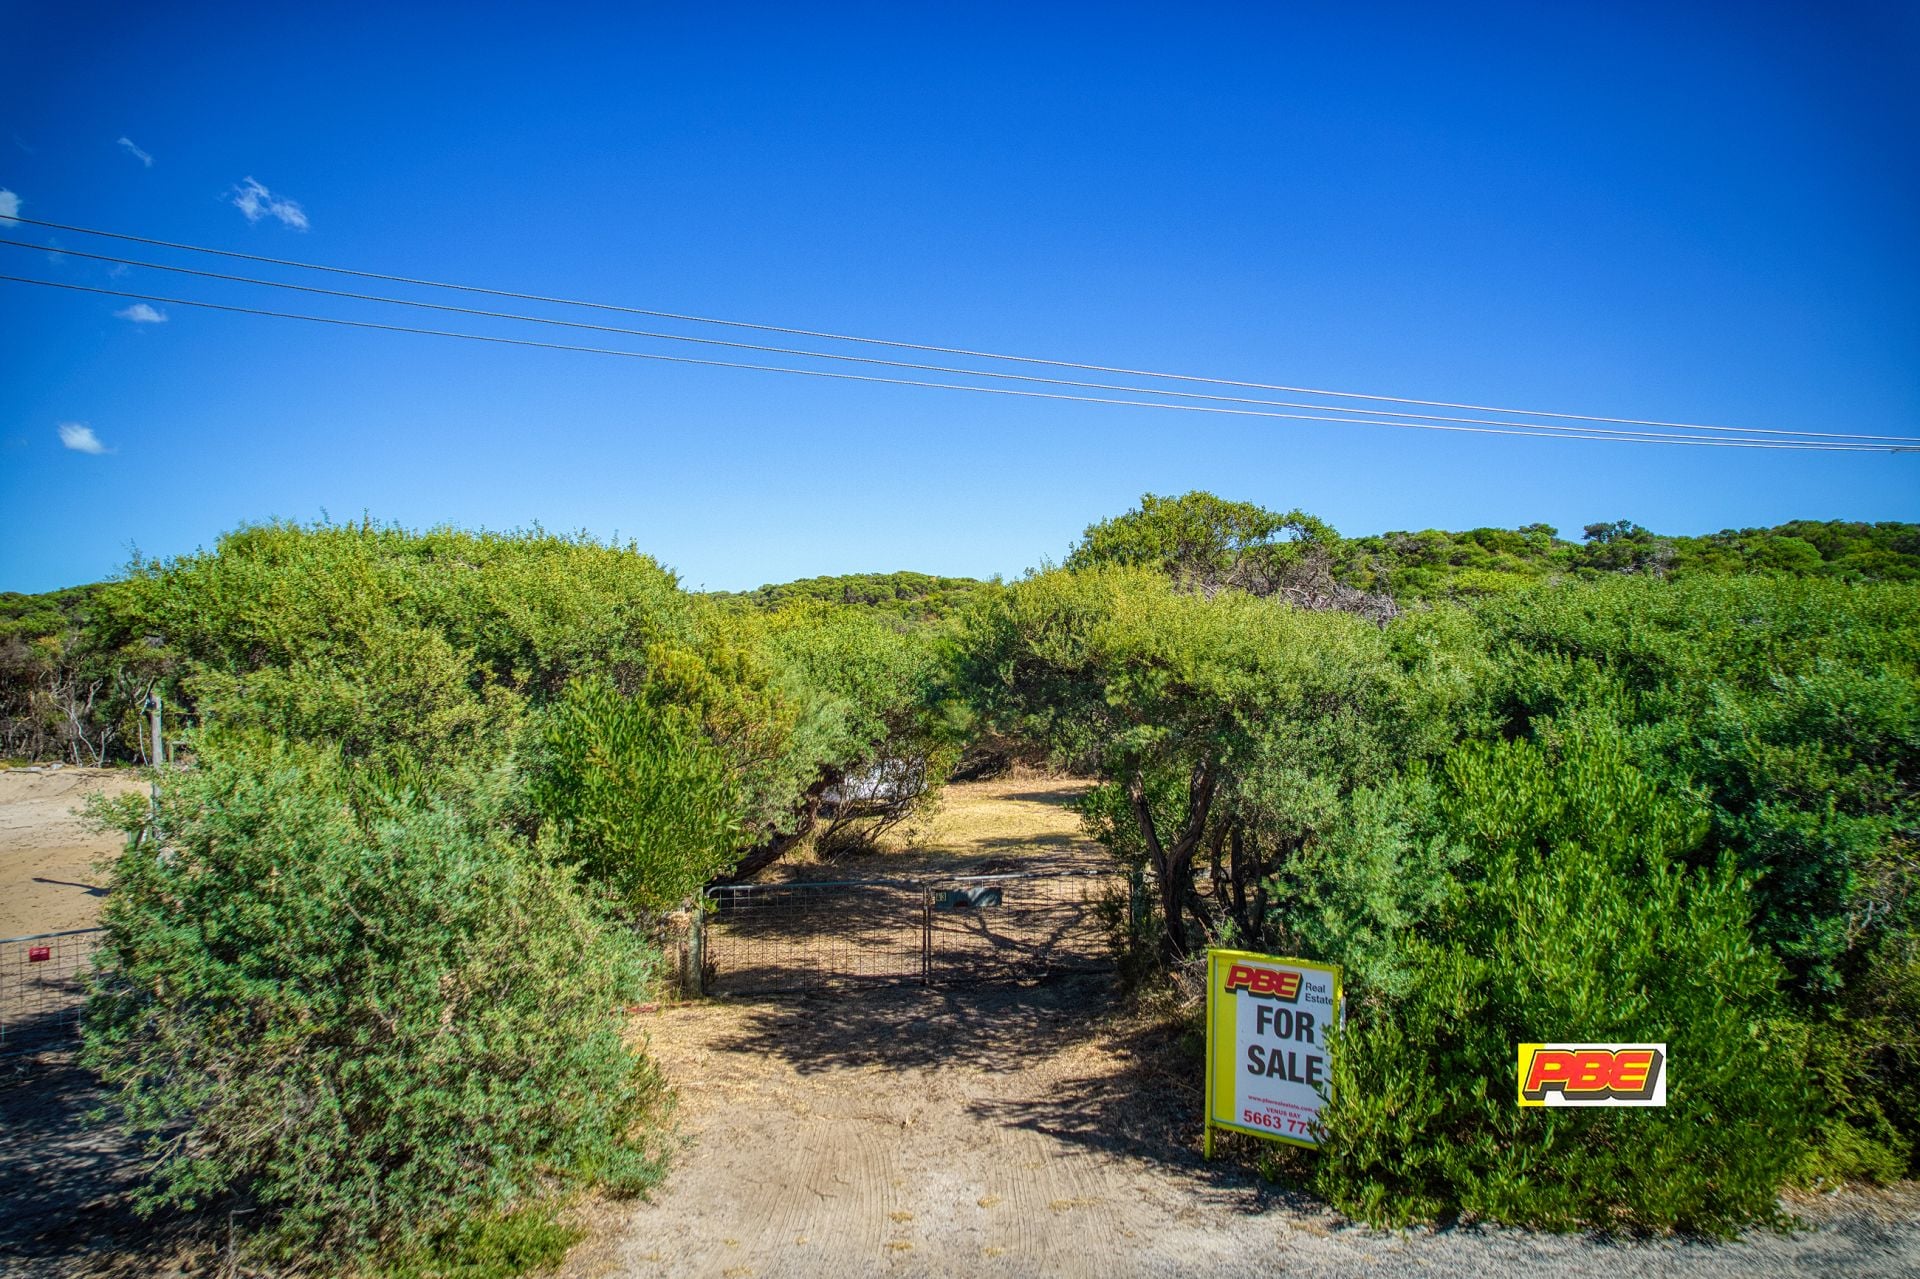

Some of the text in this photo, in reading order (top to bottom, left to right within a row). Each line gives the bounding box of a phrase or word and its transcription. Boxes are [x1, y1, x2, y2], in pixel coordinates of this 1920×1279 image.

[1225, 963, 1301, 1000] PBE
[1305, 981, 1326, 993] Real
[1305, 993, 1333, 1006] Estate
[1256, 1004, 1315, 1044] FOR
[1247, 1044, 1323, 1086] SALE
[1243, 1109, 1282, 1130] 5663
[1265, 1106, 1302, 1119] VENUS BAY
